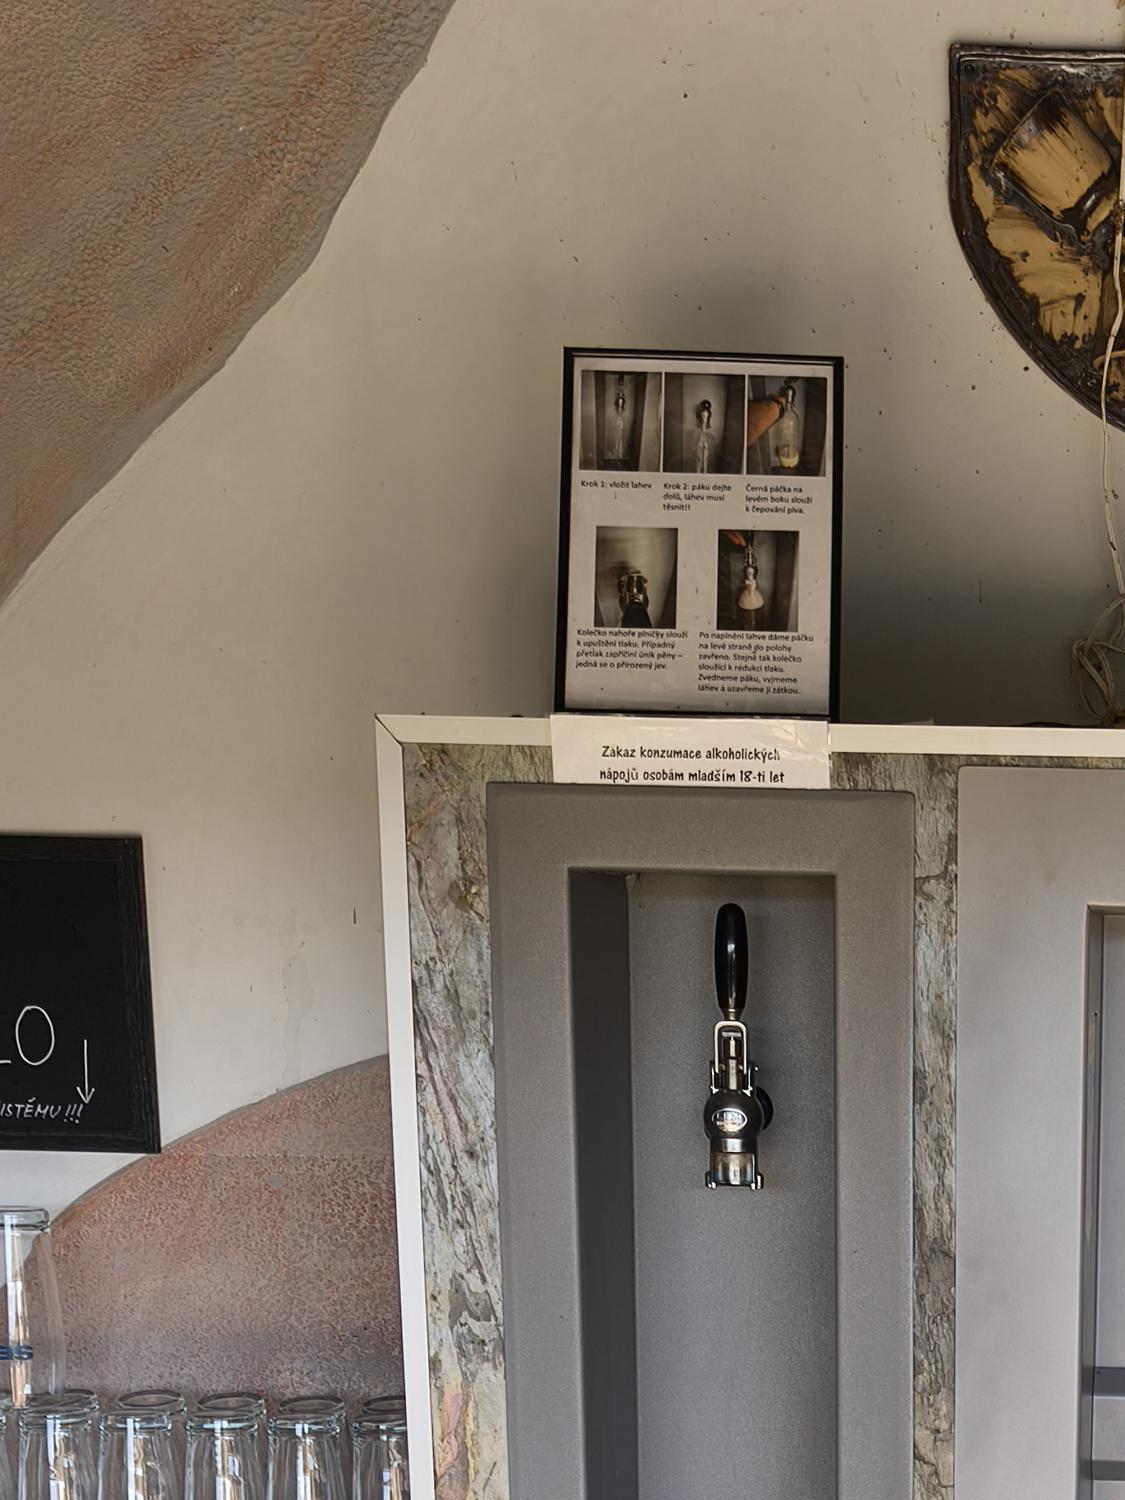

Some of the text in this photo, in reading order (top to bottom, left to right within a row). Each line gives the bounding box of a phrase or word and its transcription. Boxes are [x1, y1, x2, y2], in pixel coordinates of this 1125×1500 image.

[602, 745, 780, 764] Zákaz konzumace alkoholických
[600, 768, 784, 784] nápojů osobám mladším 18-ti let
